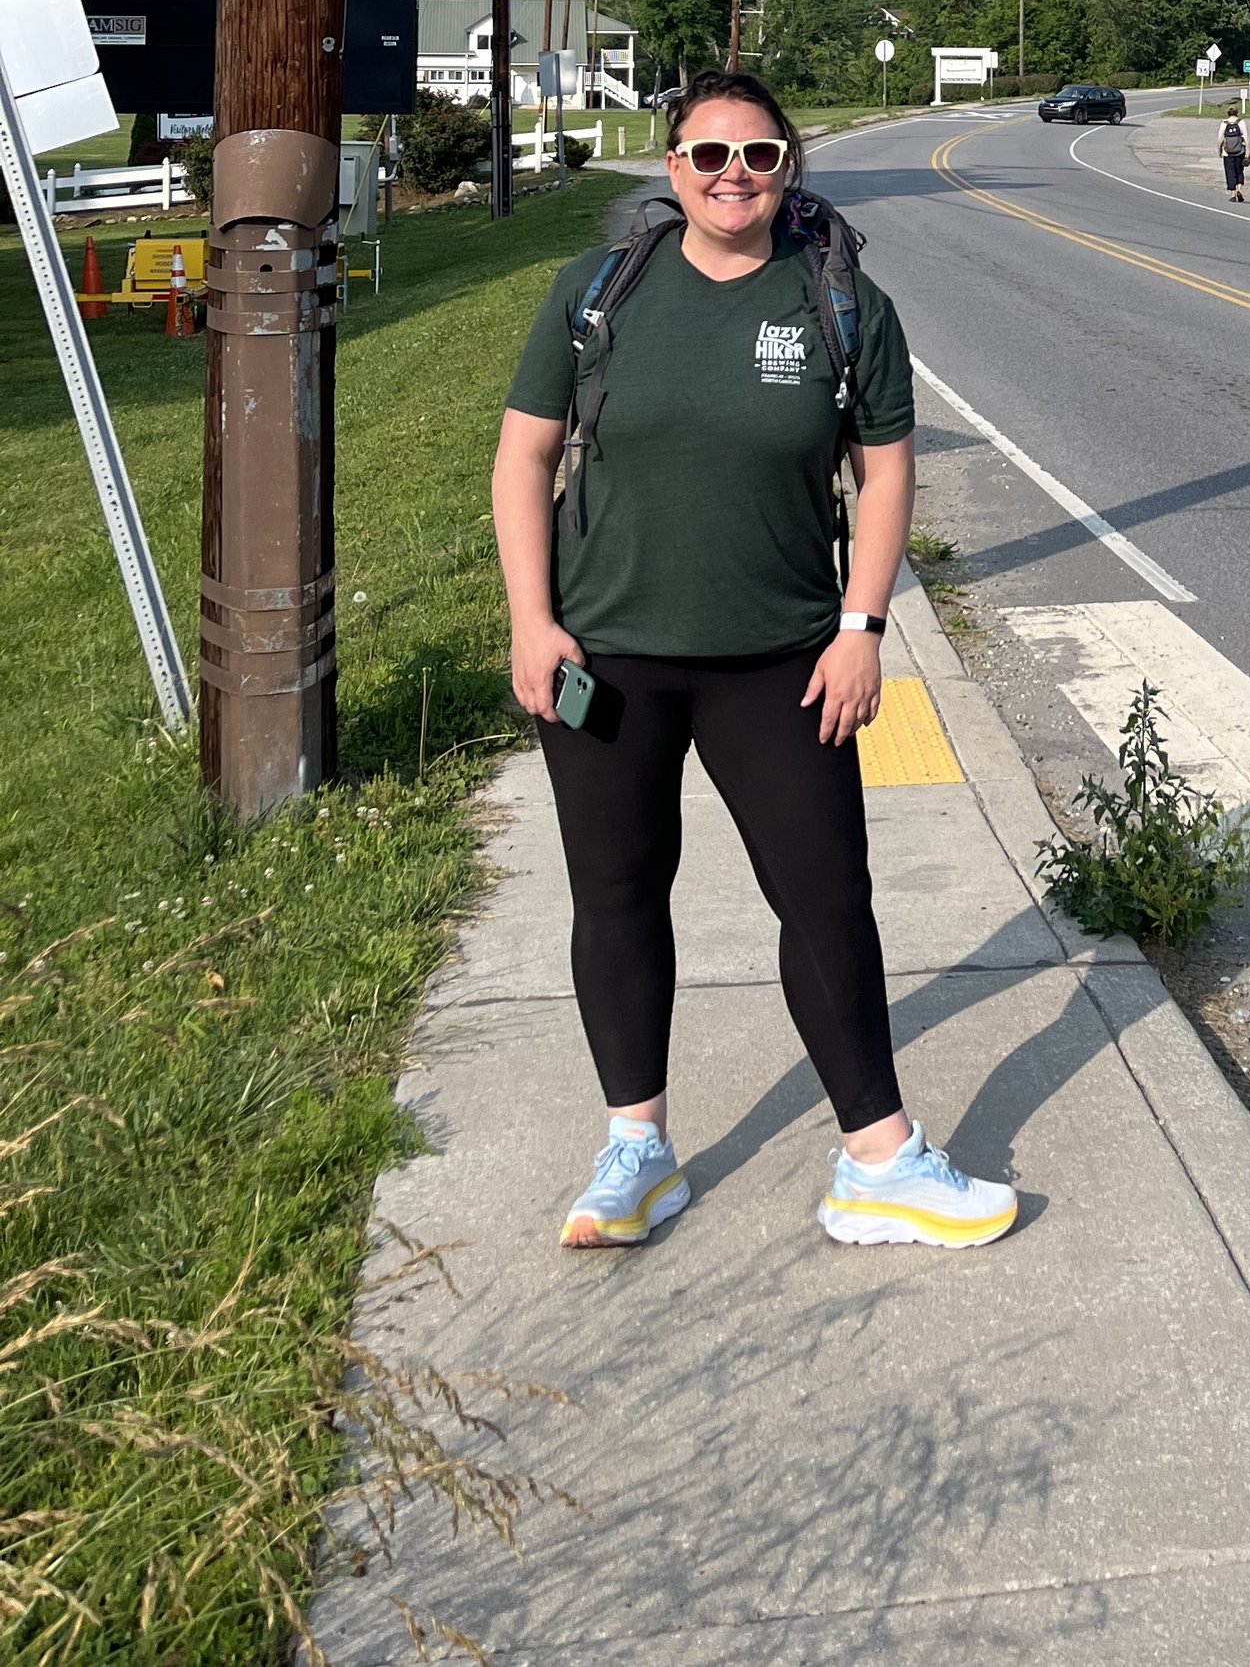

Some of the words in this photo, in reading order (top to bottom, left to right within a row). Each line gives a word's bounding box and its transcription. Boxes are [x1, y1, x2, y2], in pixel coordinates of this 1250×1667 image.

[89, 18, 142, 32] AMSIG
[758, 320, 805, 344] Lazy
[755, 340, 806, 360] HIKER
